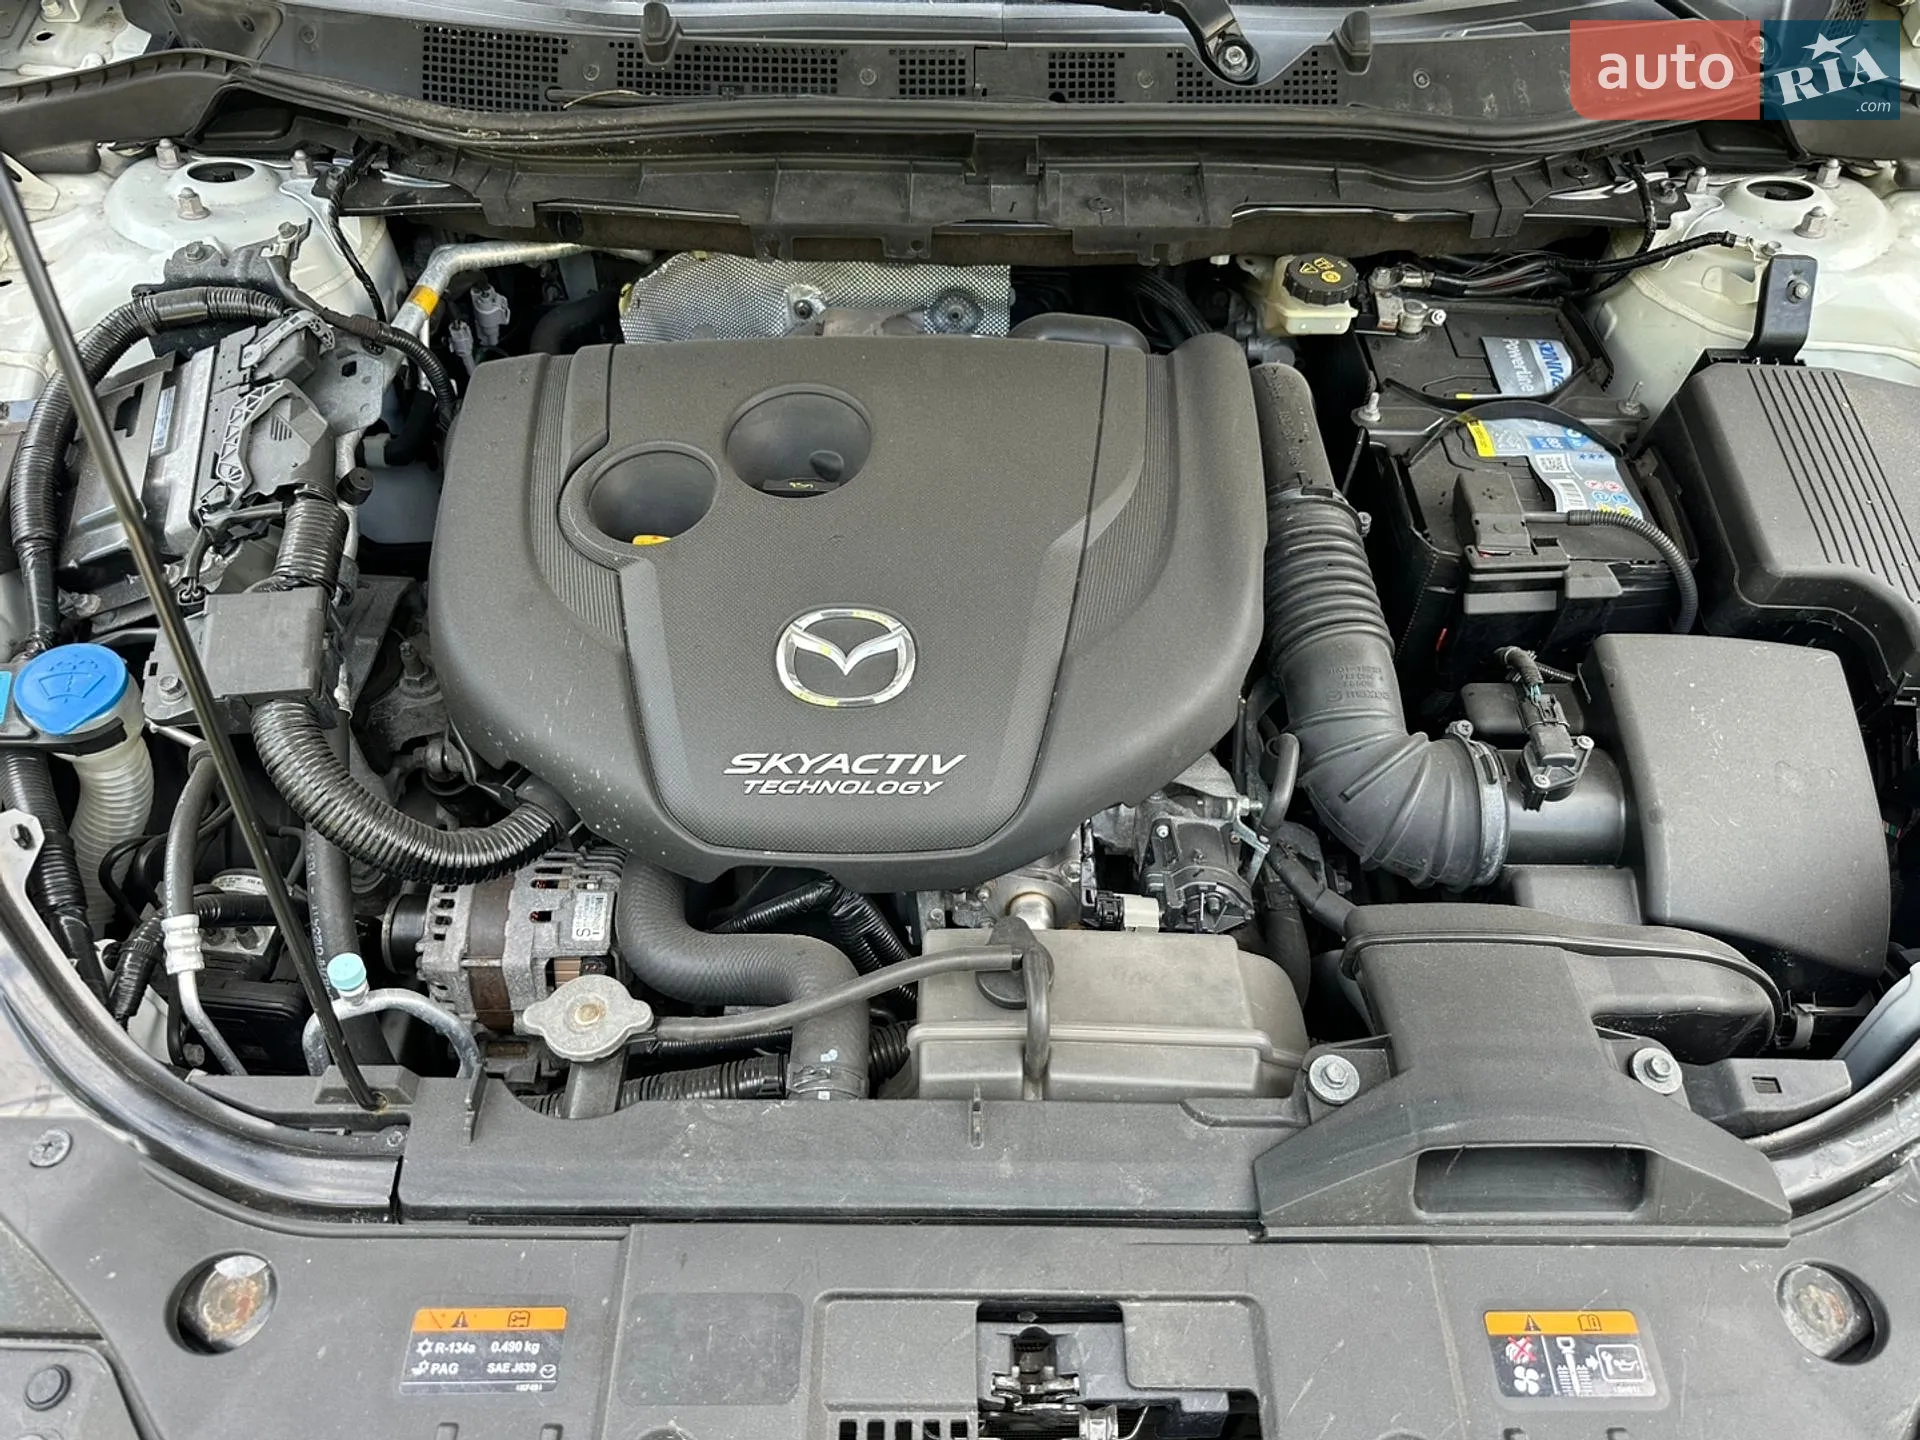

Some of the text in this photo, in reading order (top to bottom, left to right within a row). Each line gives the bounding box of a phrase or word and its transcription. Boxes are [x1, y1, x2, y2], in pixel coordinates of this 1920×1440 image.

[1503, 339, 1534, 391] Powerline
[723, 753, 968, 775] SKYACTIV
[743, 779, 944, 795] TECHNOLOGY
[435, 1341, 476, 1355] R-134a
[524, 1340, 540, 1355] kg
[430, 1362, 459, 1376] PAG
[487, 1362, 512, 1374] SAE
